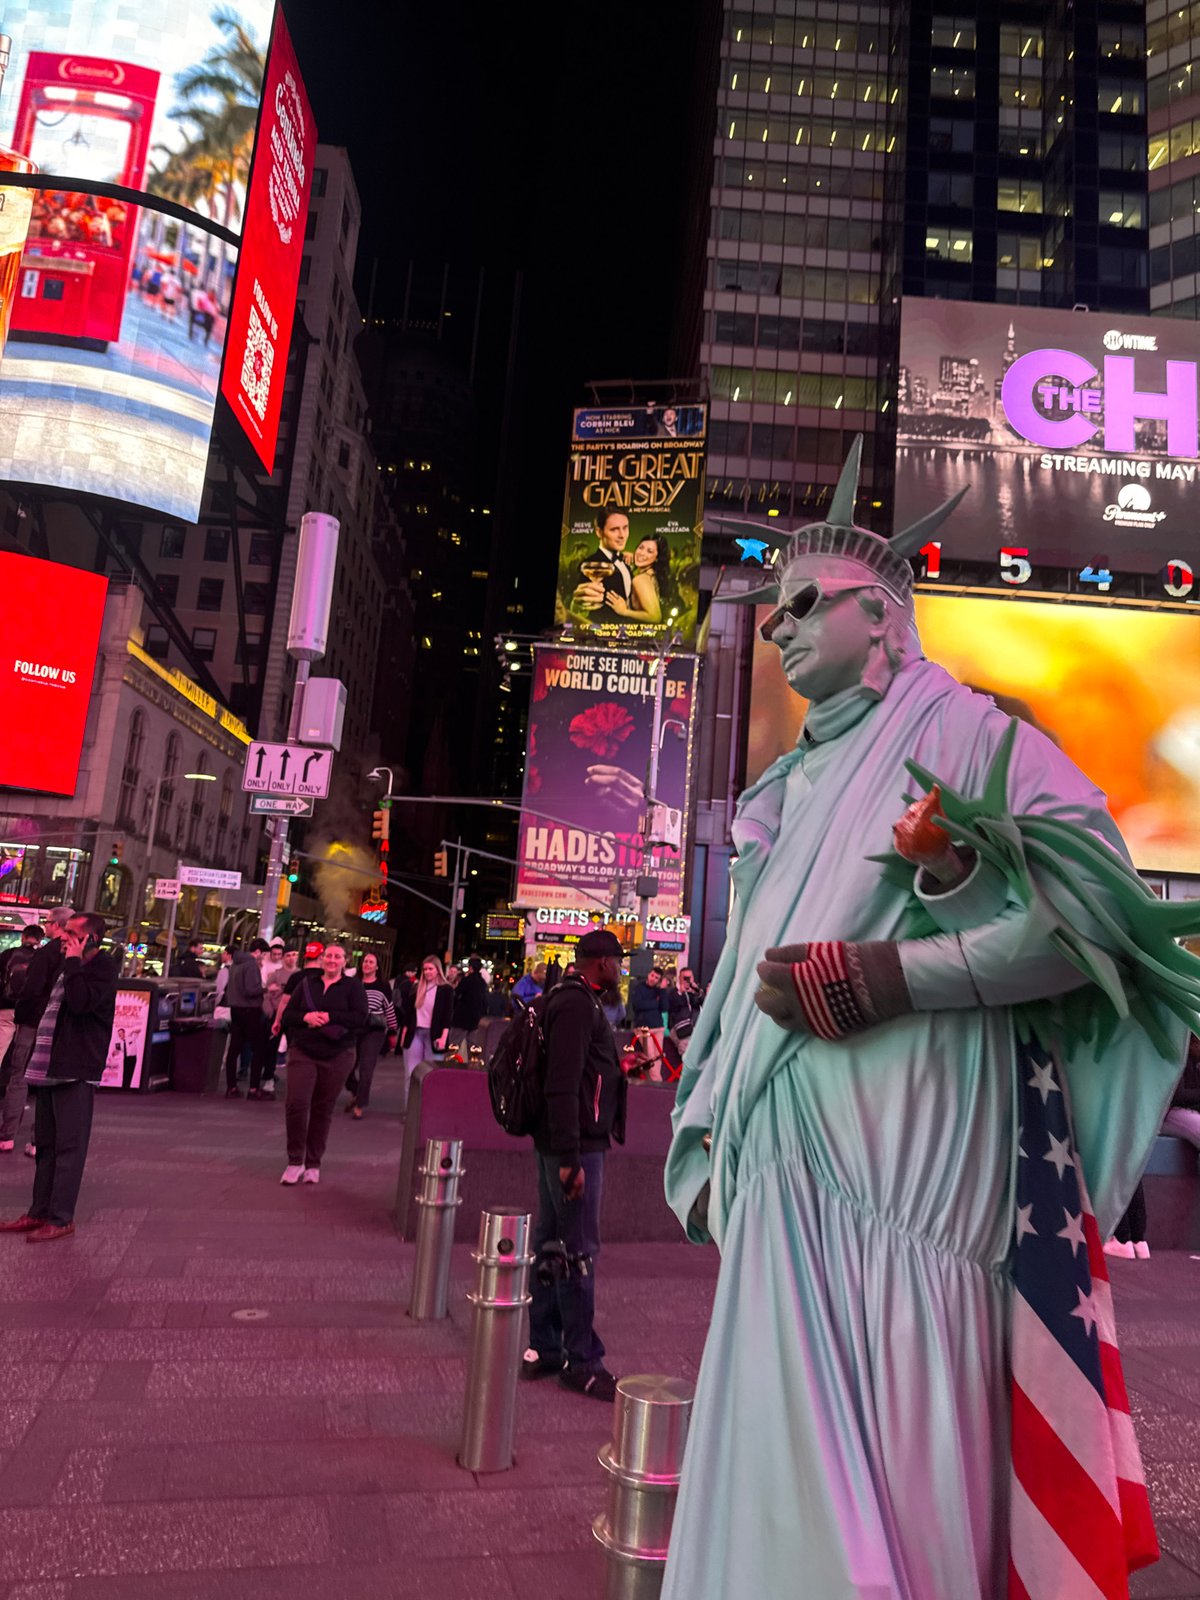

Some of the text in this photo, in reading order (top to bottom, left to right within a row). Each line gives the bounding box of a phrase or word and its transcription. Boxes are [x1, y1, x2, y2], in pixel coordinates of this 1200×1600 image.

[253, 278, 279, 340] FOLLOW US
[1038, 386, 1101, 412] THE
[580, 420, 612, 428] CORBIN
[617, 442, 649, 450] ROARING
[664, 441, 704, 449] BROADWAY
[572, 452, 704, 480] THE GREAT
[1040, 454, 1197, 482] STREAMING MAY
[583, 480, 686, 507] GATSBY
[14, 660, 60, 679] FOLLOW
[62, 669, 77, 684] US
[566, 655, 668, 677] COME SEE HOW TE
[544, 668, 603, 691] WORLD
[665, 680, 687, 699] BE
[247, 779, 322, 793] ONLY ONLY ONLY
[260, 800, 304, 810] ONE WAY
[627, 868, 680, 881] SATION
[536, 908, 590, 927] GIFTS
